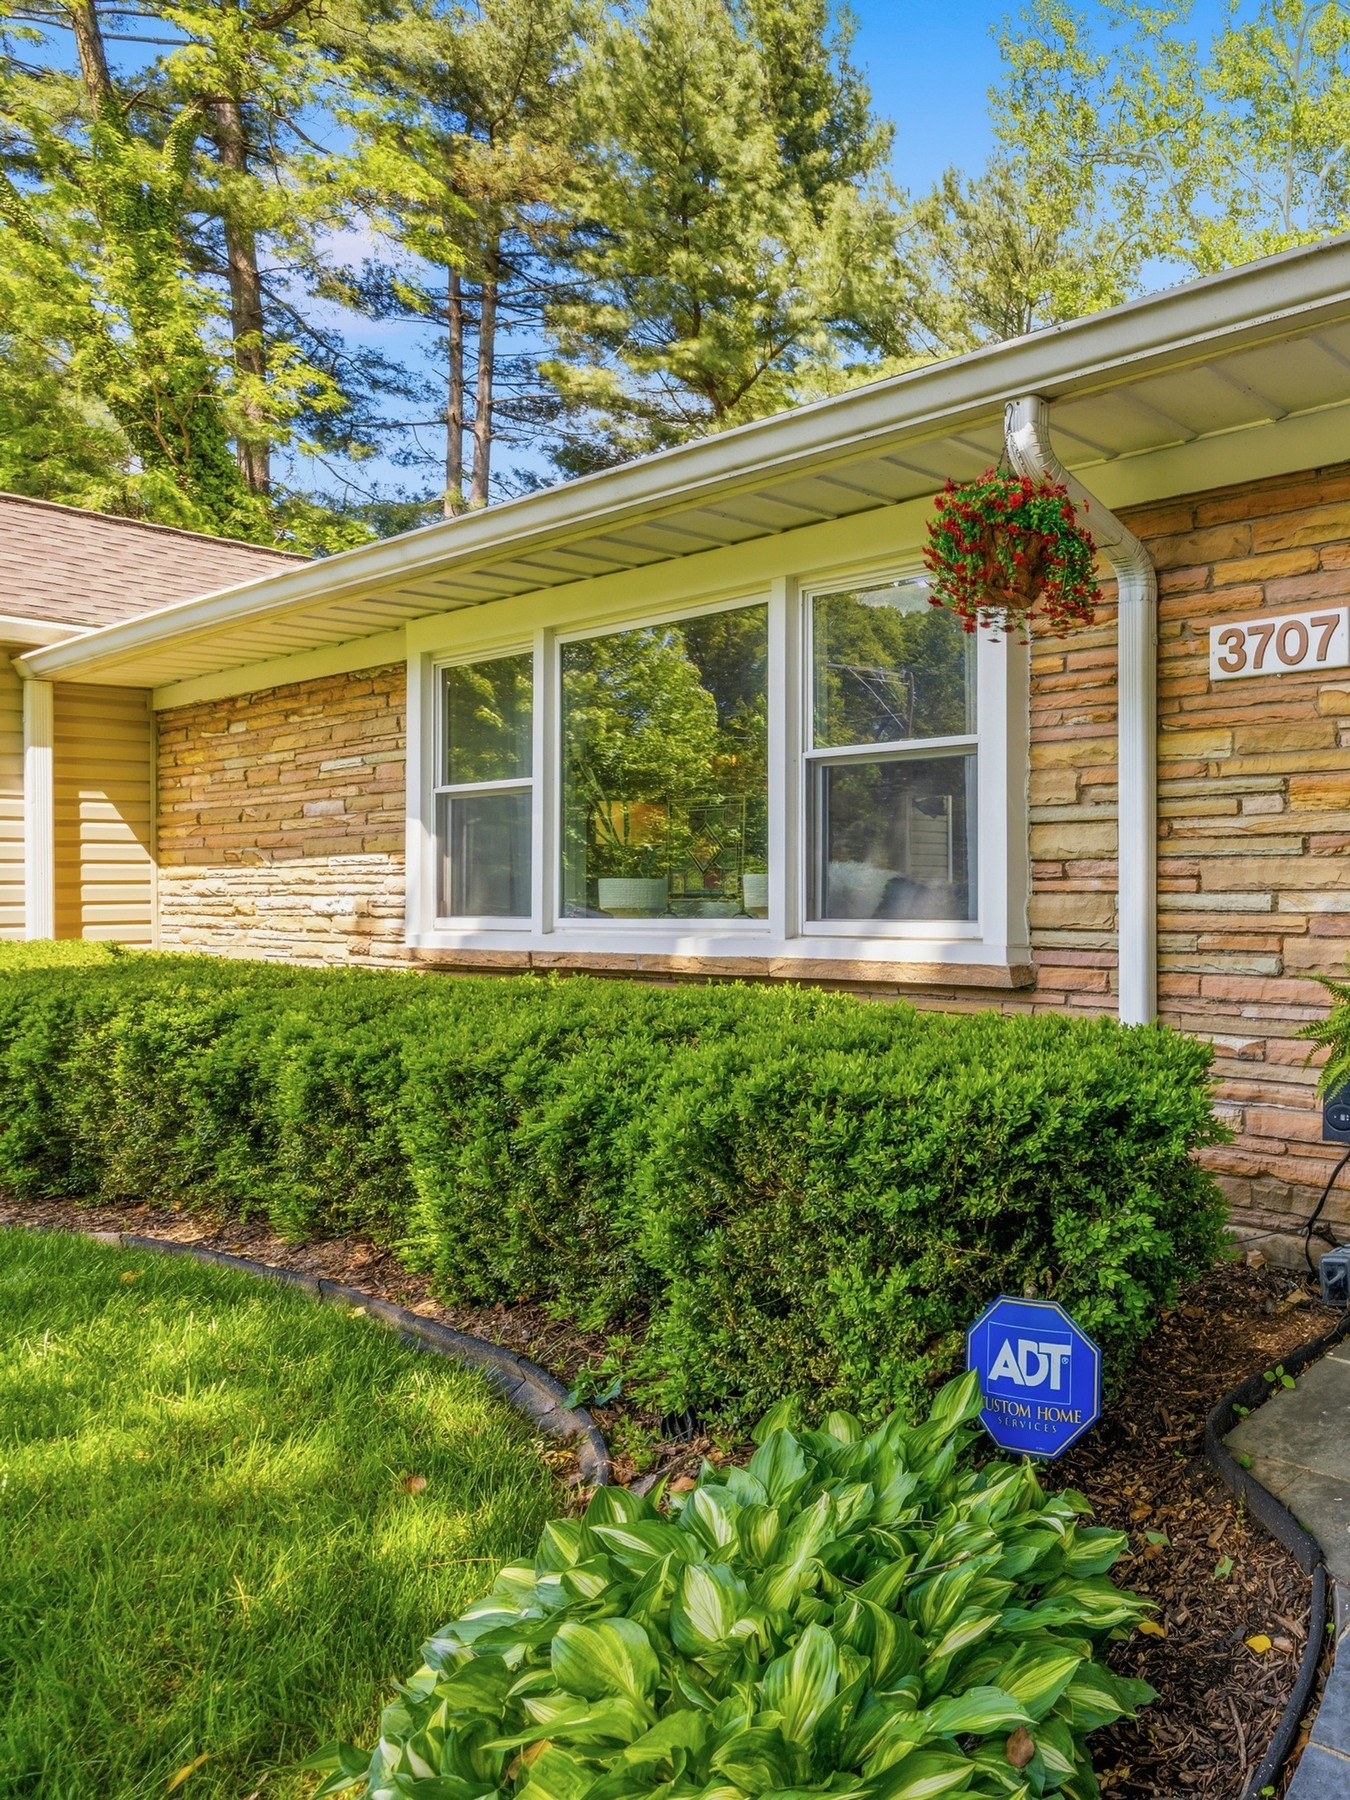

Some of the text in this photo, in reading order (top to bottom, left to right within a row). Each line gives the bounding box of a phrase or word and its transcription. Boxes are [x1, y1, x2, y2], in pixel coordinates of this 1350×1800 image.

[1218, 614, 1340, 673] 3707
[988, 1338, 1072, 1391] ADT
[983, 1396, 1082, 1424] USTOM HOME
[998, 1416, 1057, 1433] SERVICES
